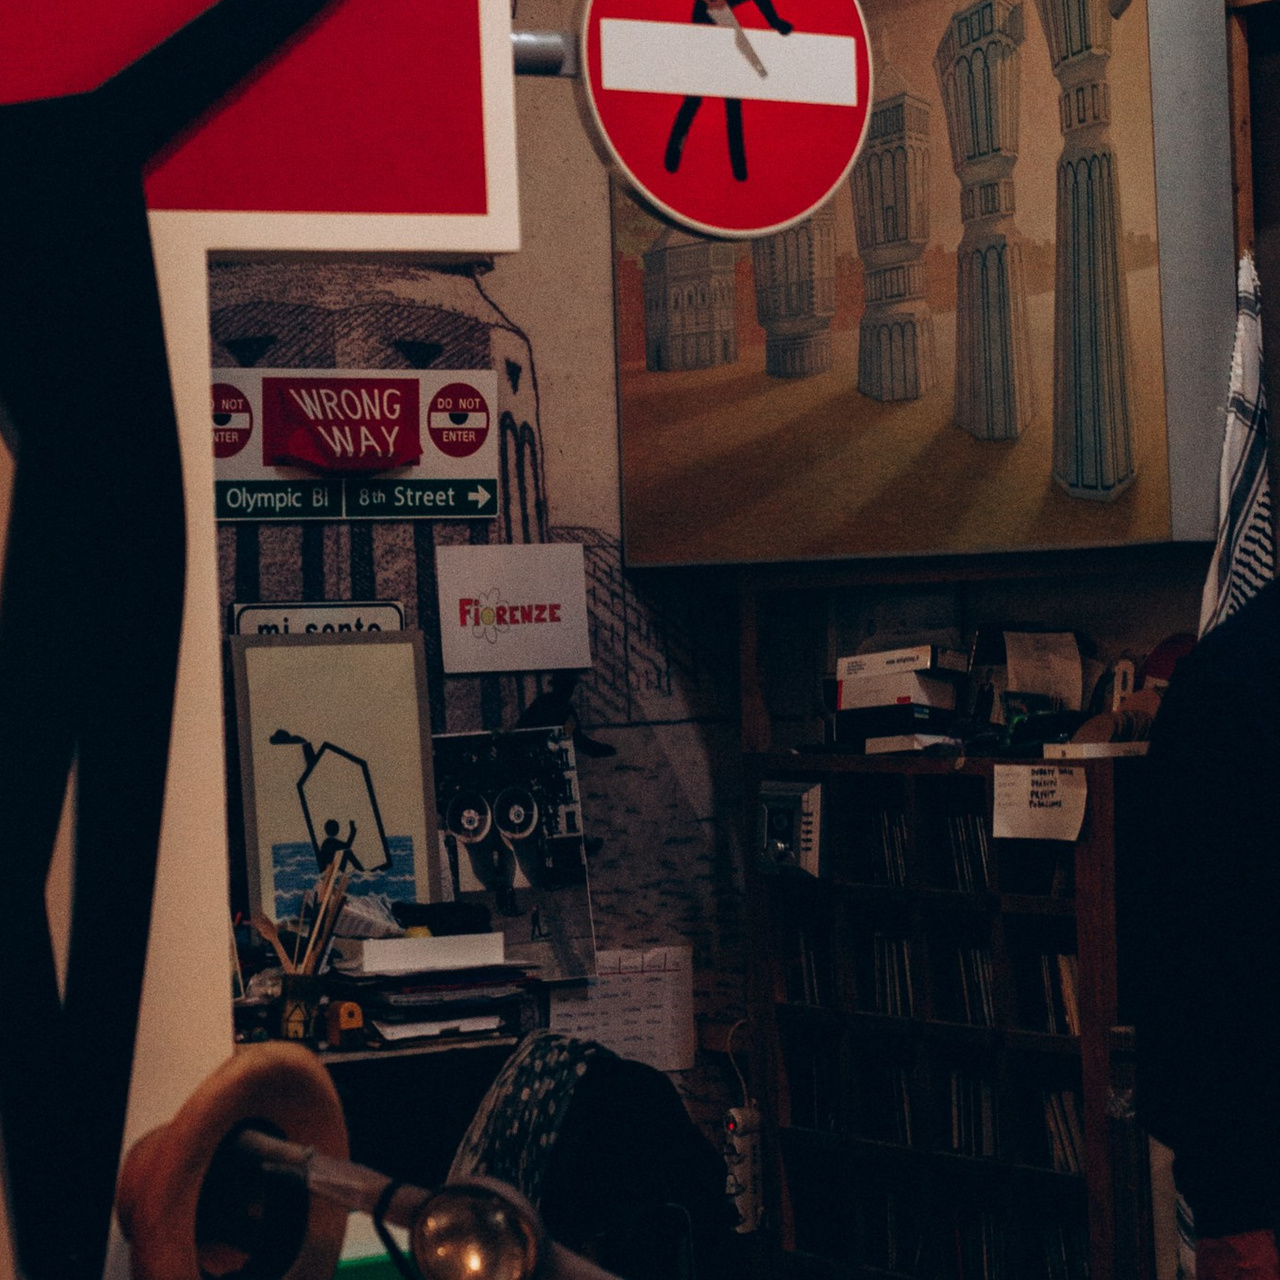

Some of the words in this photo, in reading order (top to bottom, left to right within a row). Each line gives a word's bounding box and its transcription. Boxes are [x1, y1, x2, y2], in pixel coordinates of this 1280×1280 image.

[220, 398, 244, 410] NOT
[288, 387, 402, 421] WRONG
[436, 398, 454, 410] DO
[458, 398, 481, 410] NOT
[317, 425, 400, 459] WAY
[441, 430, 477, 443] ENTER
[225, 487, 302, 513] Olympic
[358, 490, 386, 506] 8th
[393, 485, 456, 507] Street
